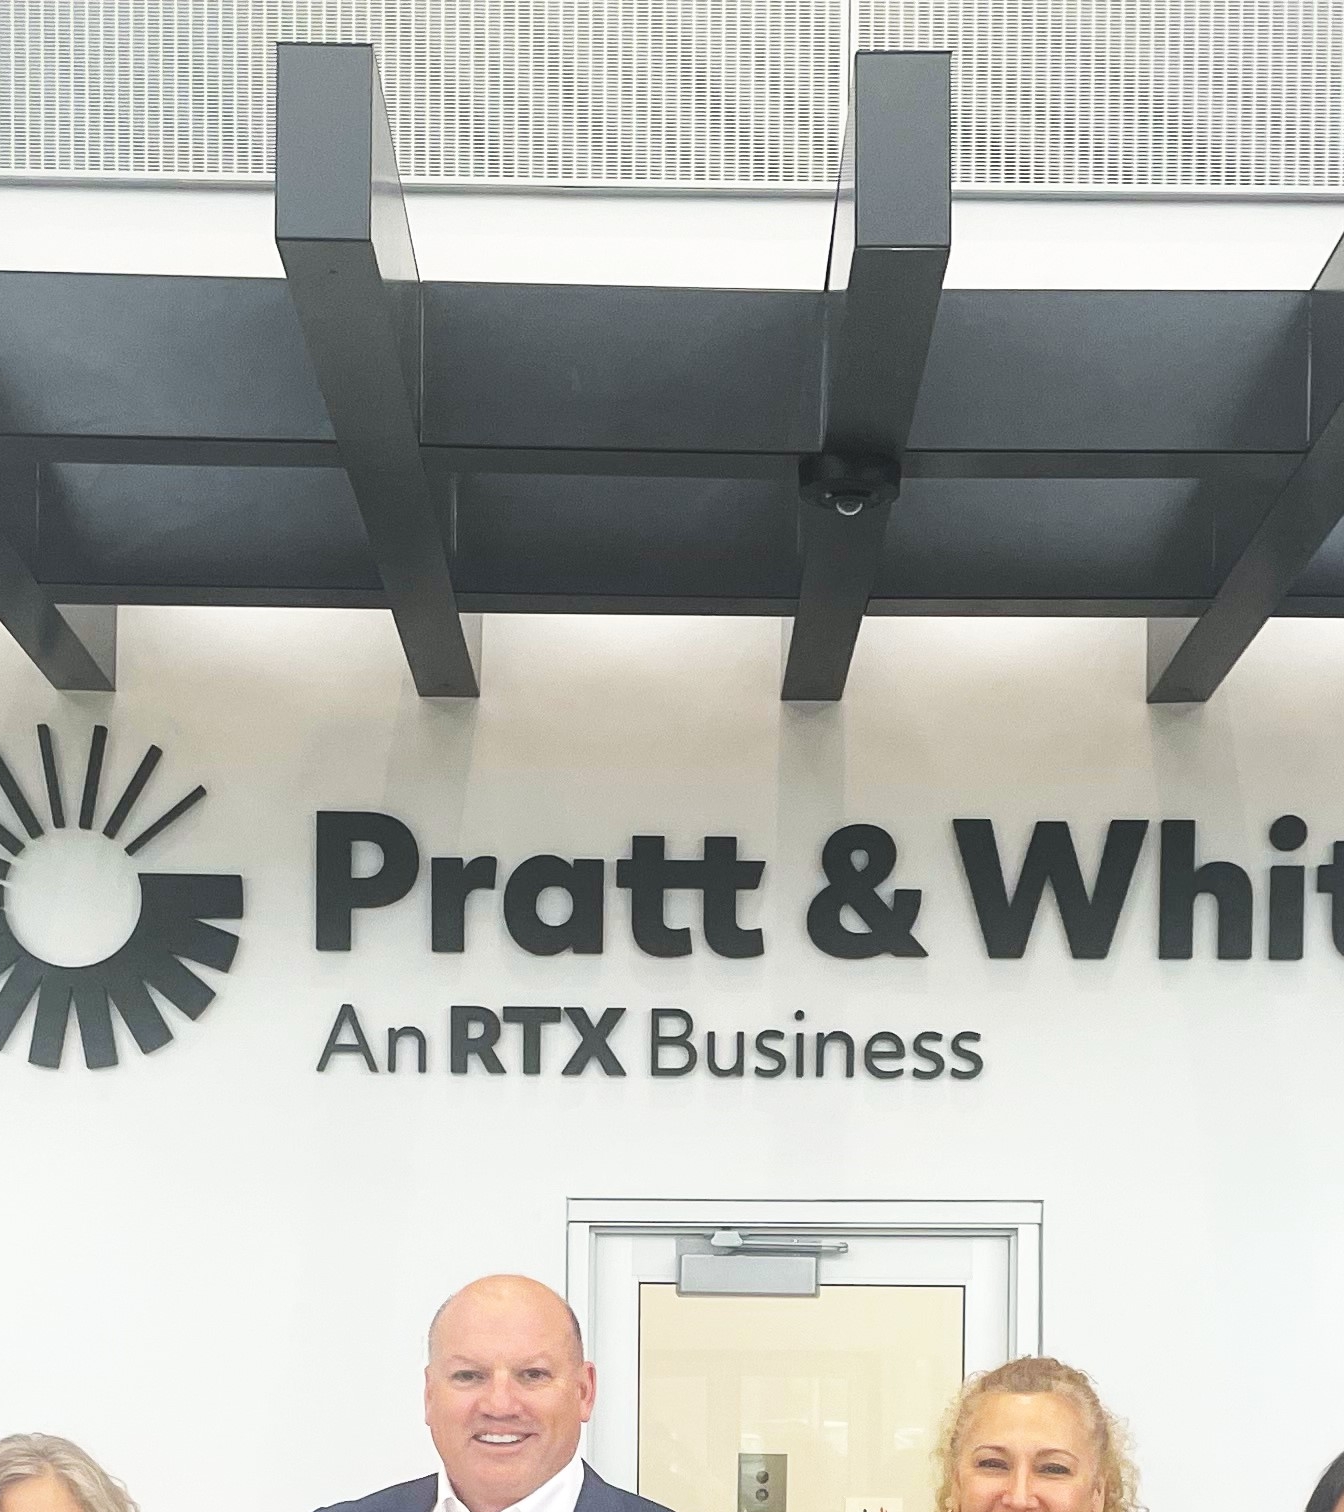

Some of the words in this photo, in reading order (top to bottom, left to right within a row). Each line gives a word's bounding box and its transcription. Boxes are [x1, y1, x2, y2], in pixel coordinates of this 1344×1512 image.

[315, 810, 767, 960] Pratt
[806, 823, 929, 960] &
[316, 1003, 428, 1074] An
[449, 1005, 628, 1077] RTX
[650, 1007, 985, 1081] Business
